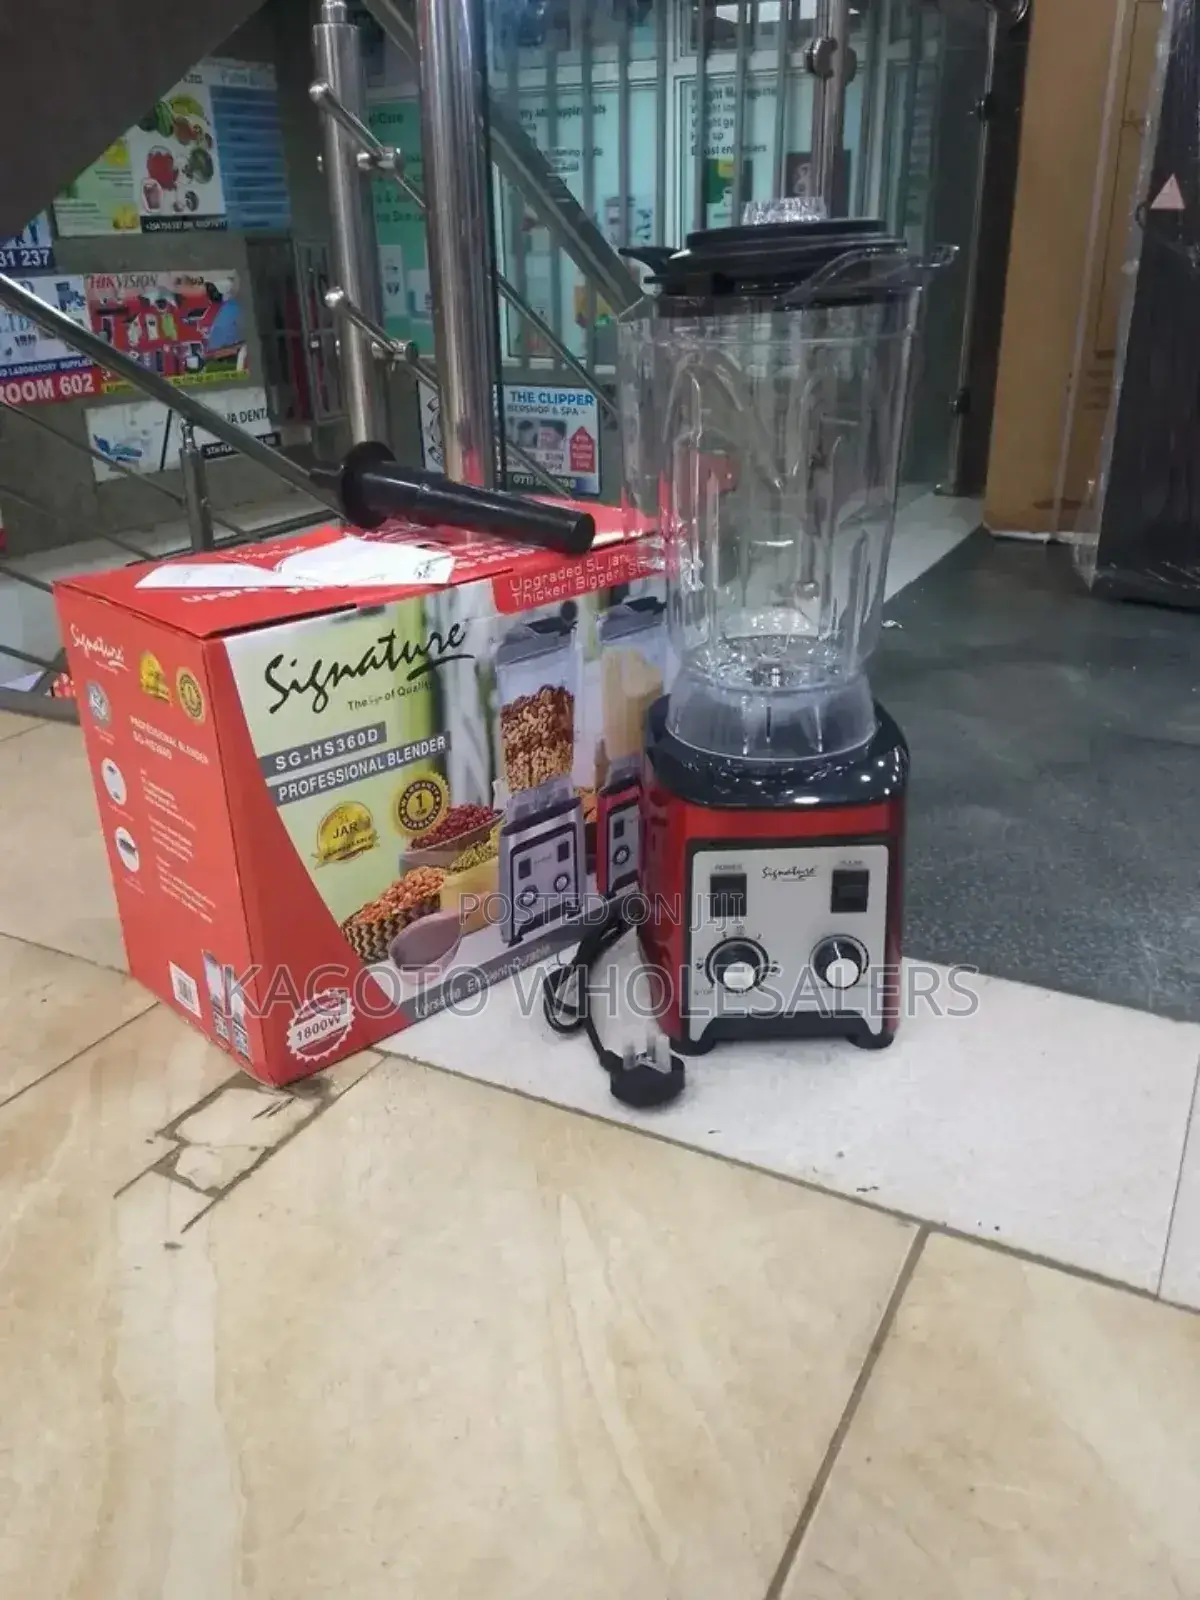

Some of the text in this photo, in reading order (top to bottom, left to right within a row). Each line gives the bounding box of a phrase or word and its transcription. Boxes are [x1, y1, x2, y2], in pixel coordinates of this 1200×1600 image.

[20, 249, 50, 266] 237
[90, 275, 158, 289] HIKVISION
[60, 373, 95, 395] 602
[510, 391, 594, 406] THE CLIPPER
[561, 406, 579, 416] SPA
[509, 564, 583, 592] Upgraded
[585, 558, 604, 573] 5L
[70, 622, 130, 672] Signature
[265, 622, 475, 714] Signature
[348, 697, 368, 711] The
[384, 690, 396, 702] of
[275, 728, 379, 770] SG-HS360D
[278, 735, 447, 801] PROFESSIONAL BLENDER
[415, 793, 423, 809] 1
[333, 821, 359, 839] JAR
[761, 865, 818, 881] Signature
[297, 1013, 341, 1042] 1800W
